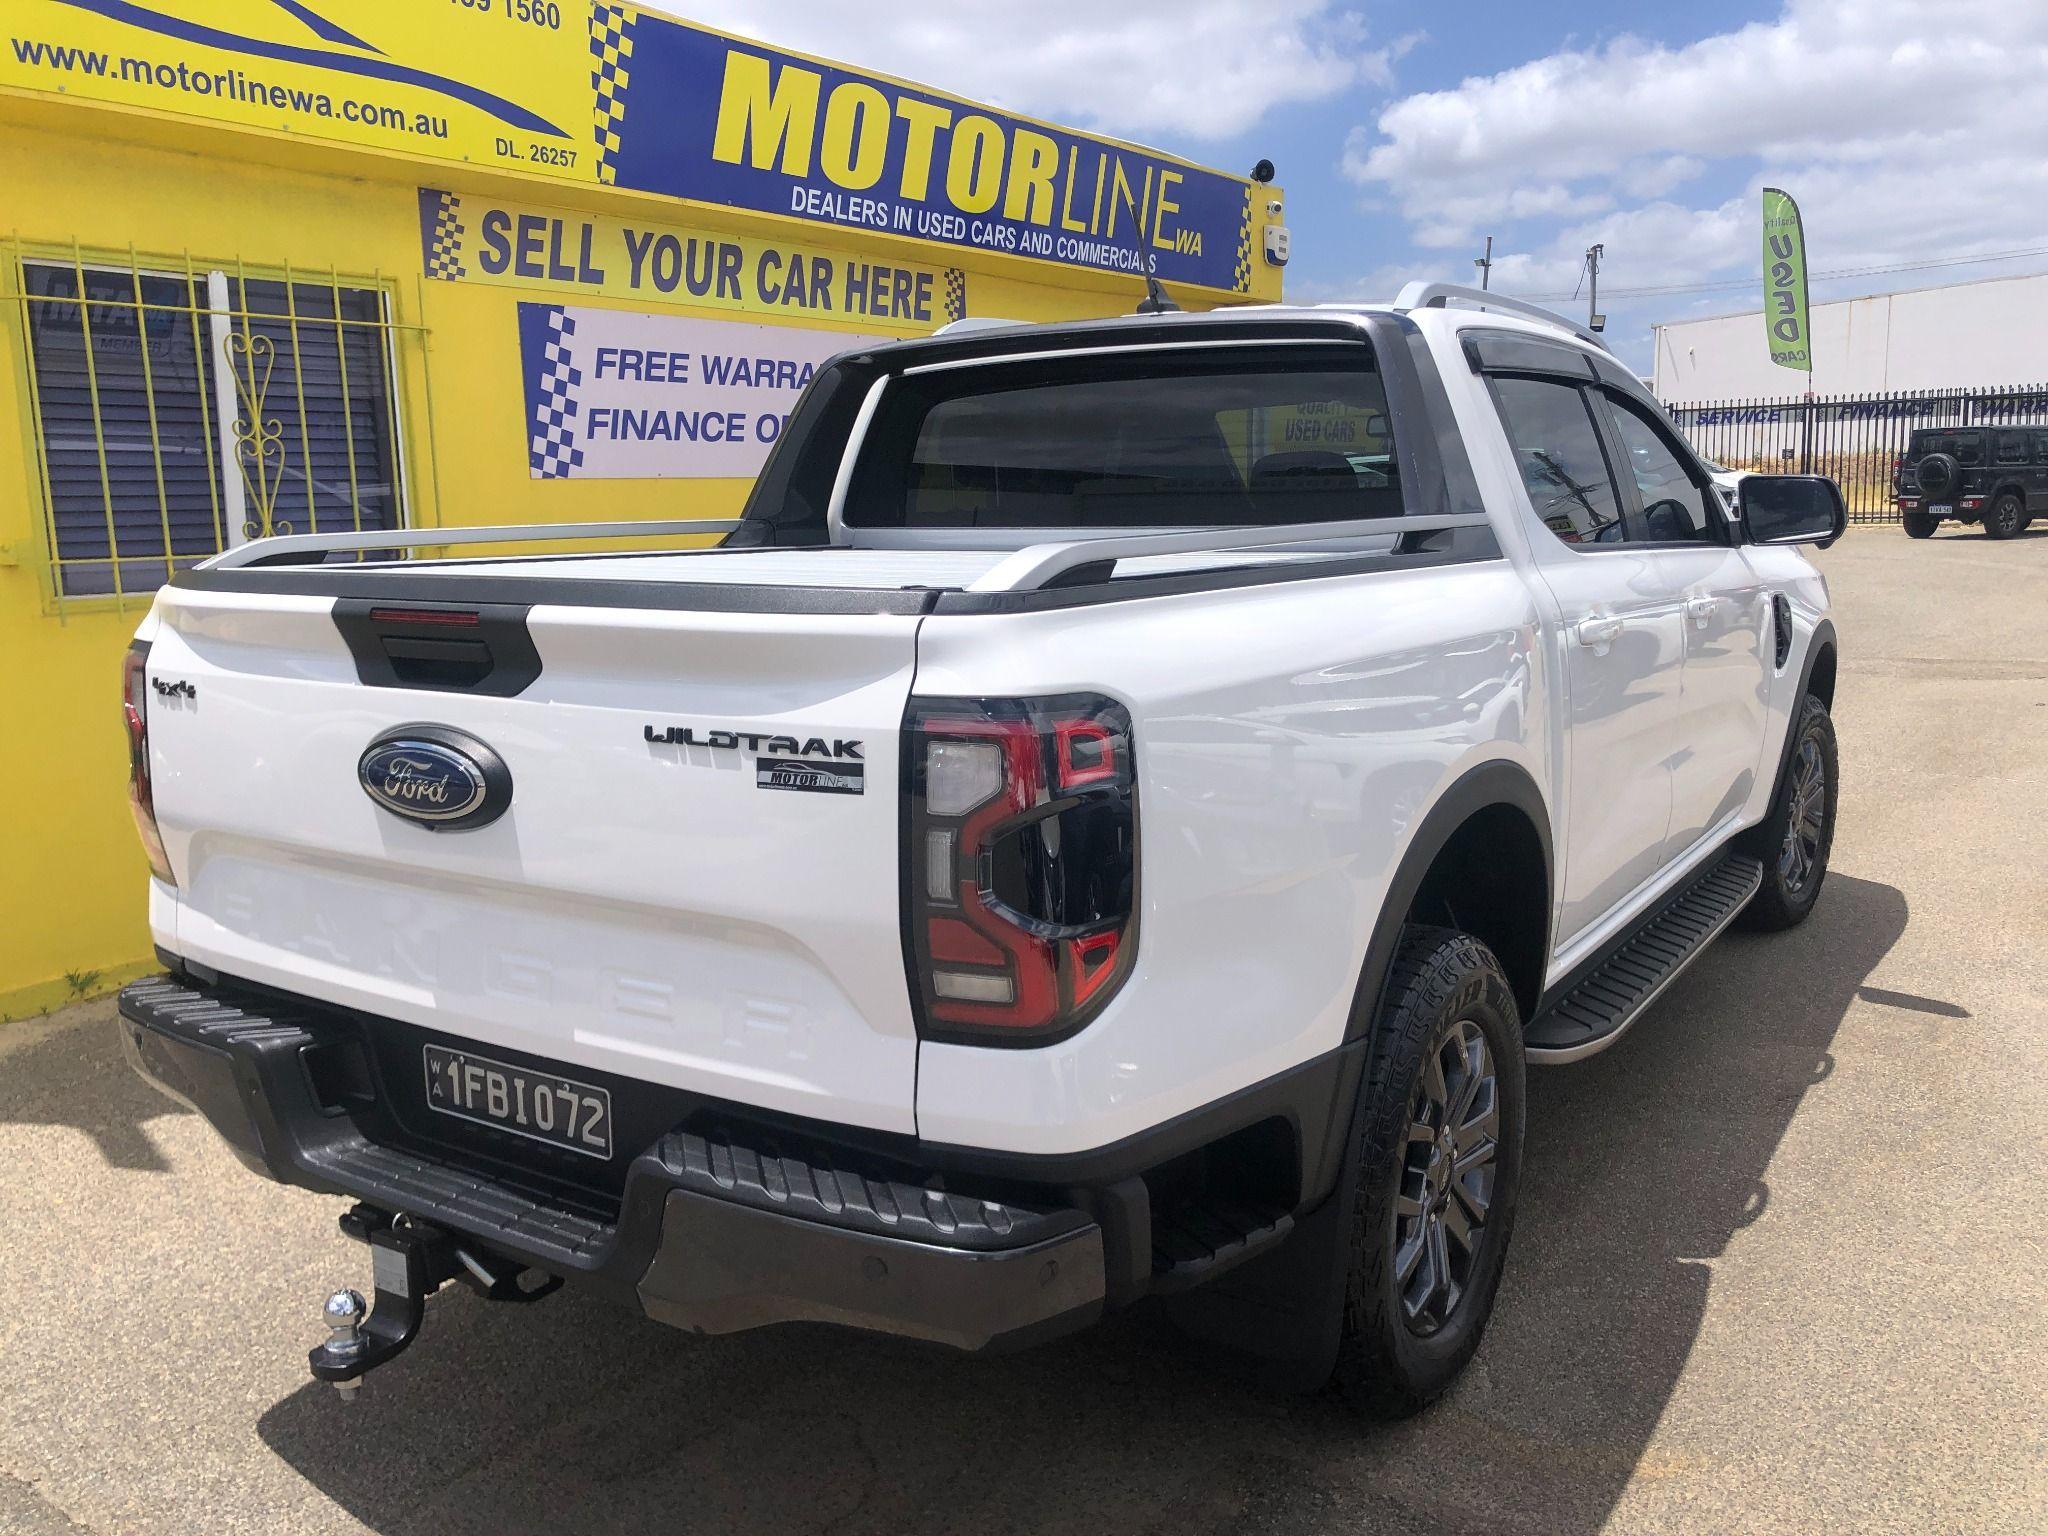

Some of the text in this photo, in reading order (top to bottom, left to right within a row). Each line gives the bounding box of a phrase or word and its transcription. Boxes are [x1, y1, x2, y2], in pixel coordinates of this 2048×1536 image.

[503, 0, 561, 30] 1560
[10, 38, 449, 139] www.motorlinewa.com.au
[495, 138, 577, 168] DL. 26257
[791, 186, 888, 227] DEALERS
[893, 205, 913, 231] IN
[917, 207, 966, 240] USED
[971, 221, 1017, 250] CARS
[1019, 230, 1053, 256] AND
[478, 209, 934, 322] SELL YOUR CAR HERE
[594, 347, 823, 389] FREE WARRA
[586, 409, 747, 442] FINANCE
[1696, 408, 1782, 425] SERVICE
[643, 724, 865, 759] WILDTRAK
[384, 756, 449, 805] Ford
[447, 1061, 606, 1148] 1FBI072
